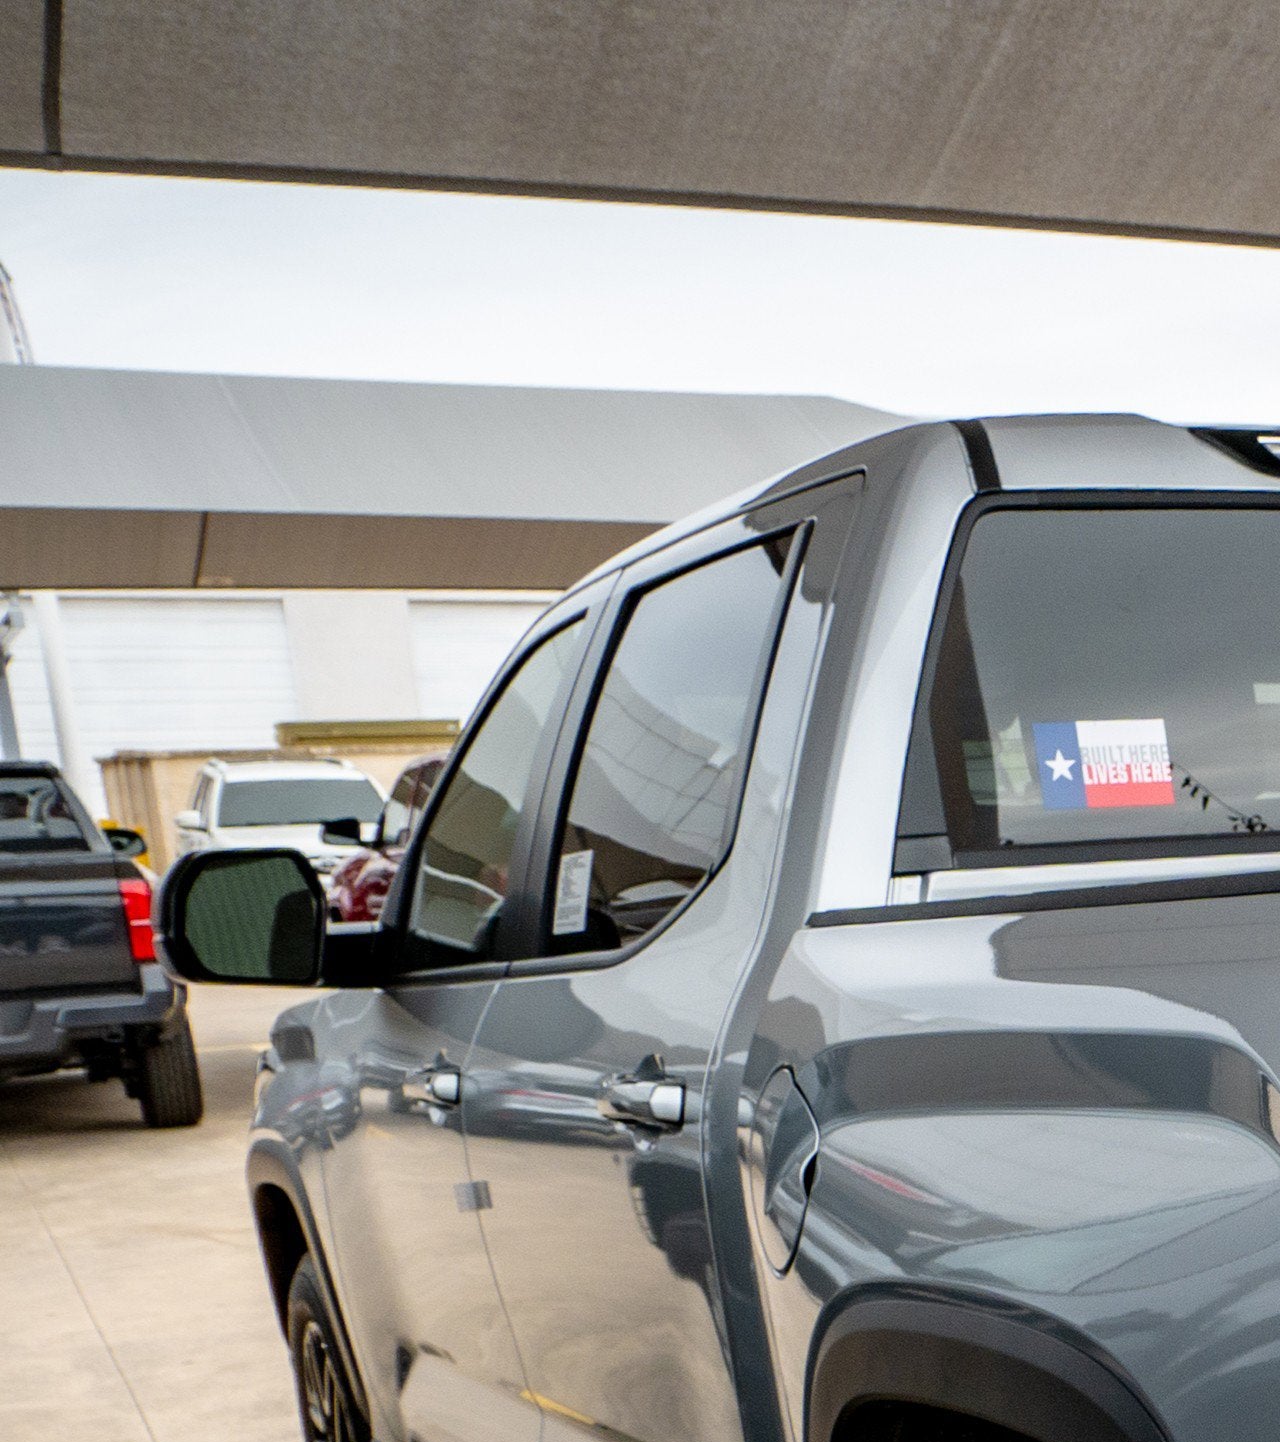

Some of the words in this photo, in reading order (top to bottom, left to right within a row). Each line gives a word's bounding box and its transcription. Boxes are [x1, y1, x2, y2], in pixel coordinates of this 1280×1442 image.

[1081, 746, 1124, 765] BUILT
[1129, 743, 1170, 763] HERE
[1082, 764, 1128, 785] LIVES
[1131, 763, 1172, 783] HERE
